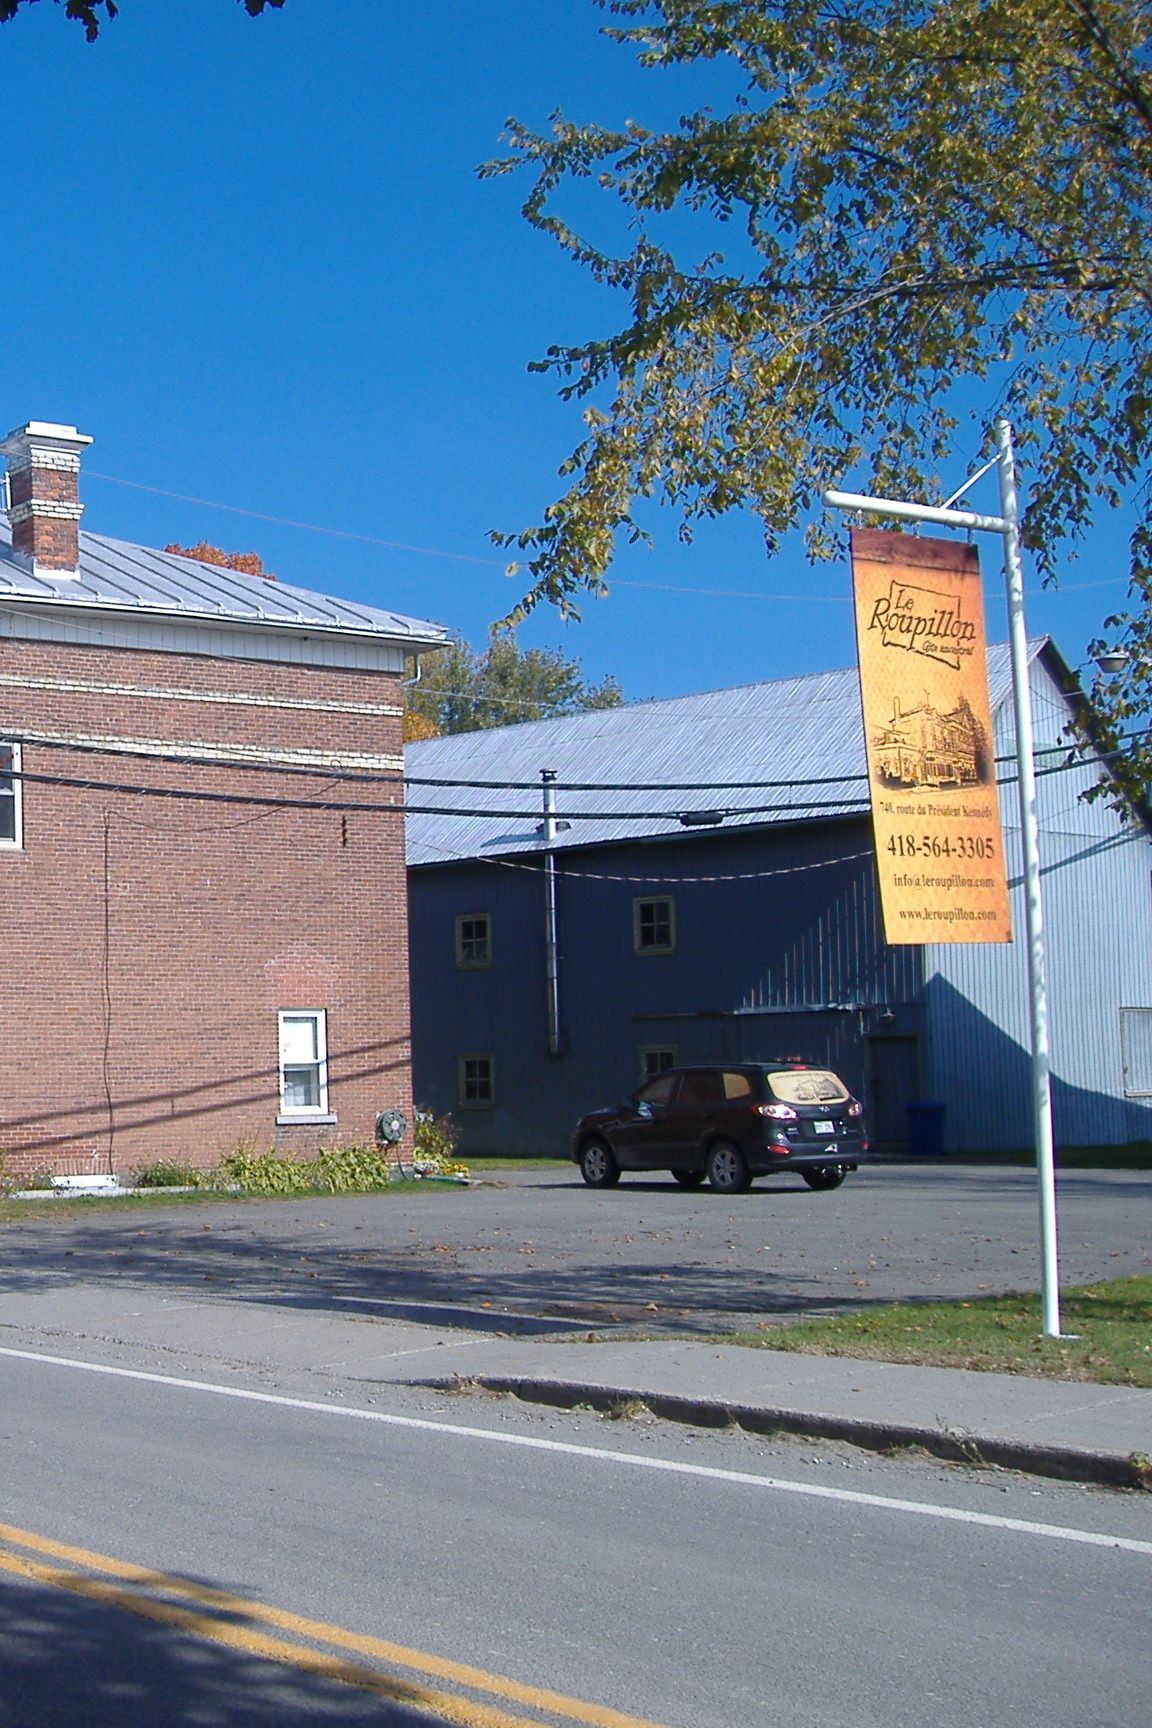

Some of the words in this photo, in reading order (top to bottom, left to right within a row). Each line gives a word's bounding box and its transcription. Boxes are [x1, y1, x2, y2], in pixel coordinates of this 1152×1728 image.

[894, 589, 913, 610] Le
[868, 598, 977, 650] Roupillon
[896, 805, 915, 816] route
[917, 805, 927, 815] du
[887, 834, 995, 859] 418-564-3305
[894, 874, 994, 891] info@leroupillon.com
[899, 907, 997, 924] www.leroupillon.com
